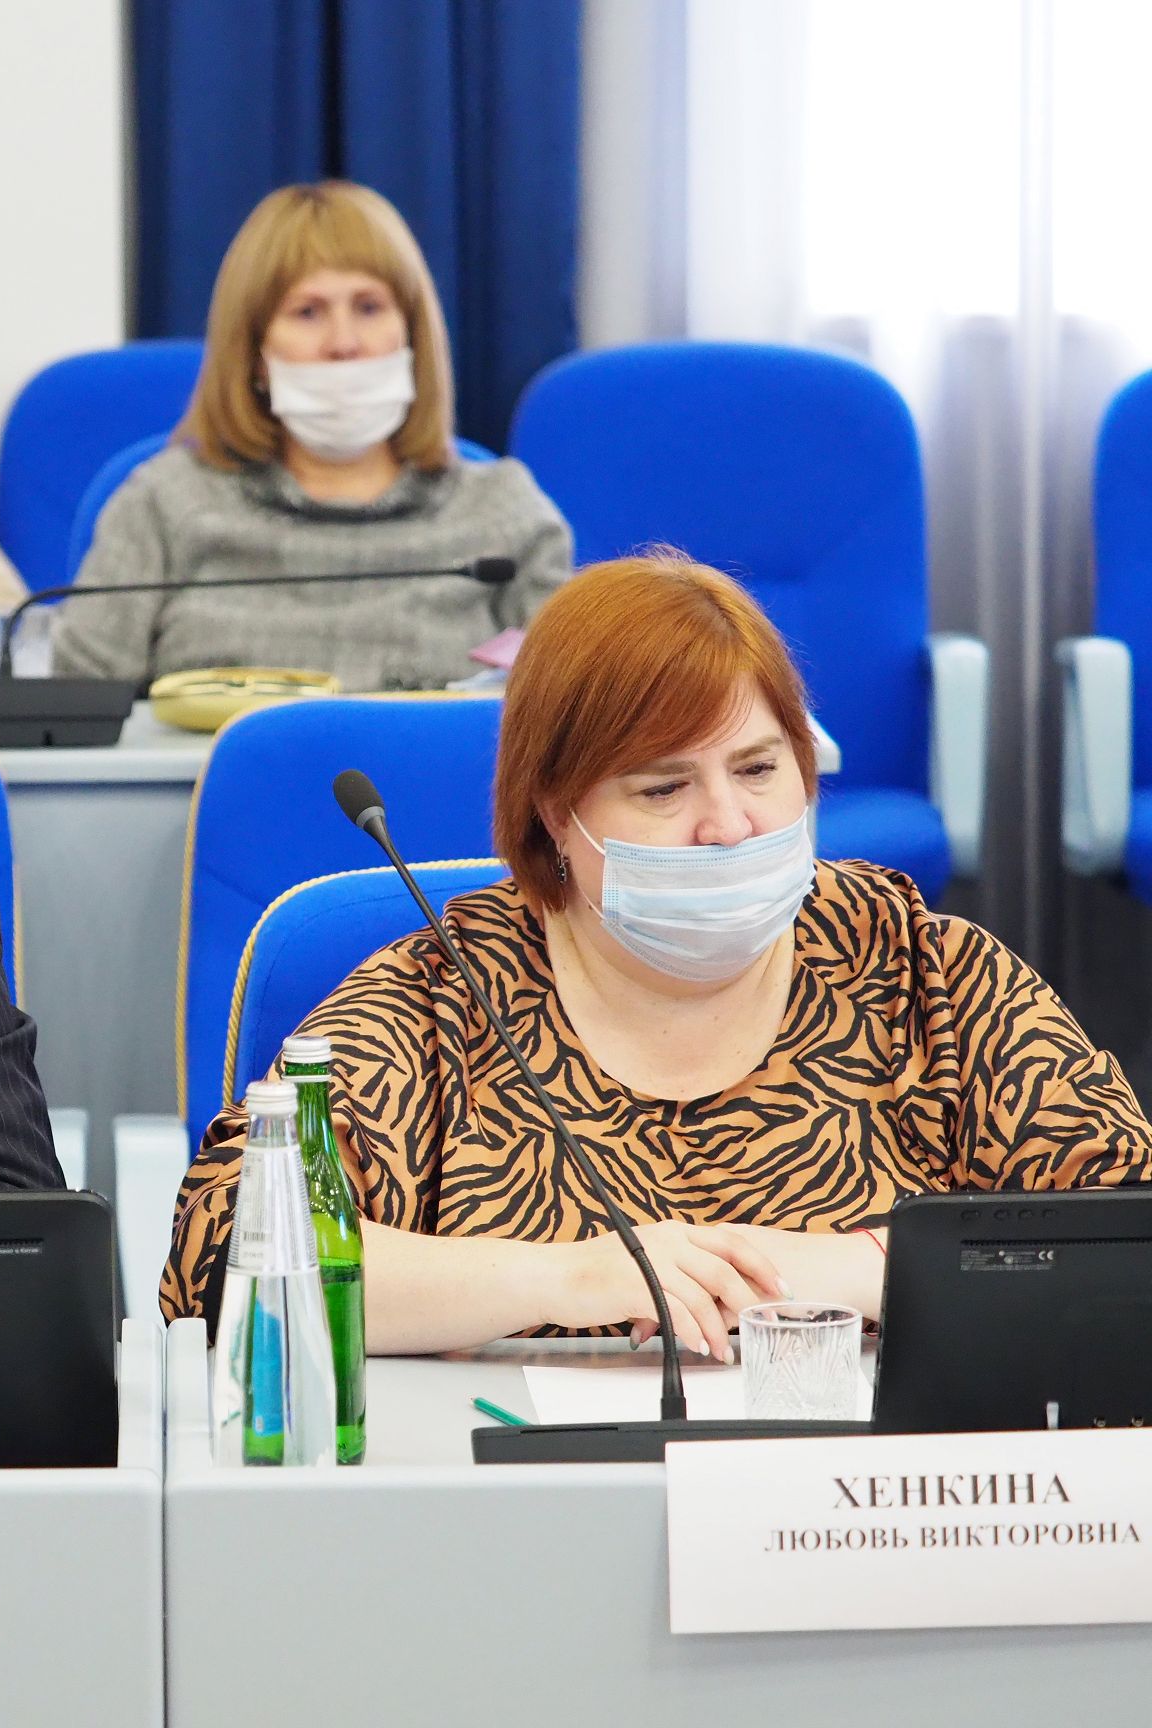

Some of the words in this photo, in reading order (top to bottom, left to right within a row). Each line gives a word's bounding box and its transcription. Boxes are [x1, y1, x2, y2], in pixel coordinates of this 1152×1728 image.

[833, 1472, 1071, 1509] ХЕНКИНА
[764, 1527, 910, 1552] ЛЮБОВЬ
[920, 1520, 1142, 1549] ВИКТОРОВНА
